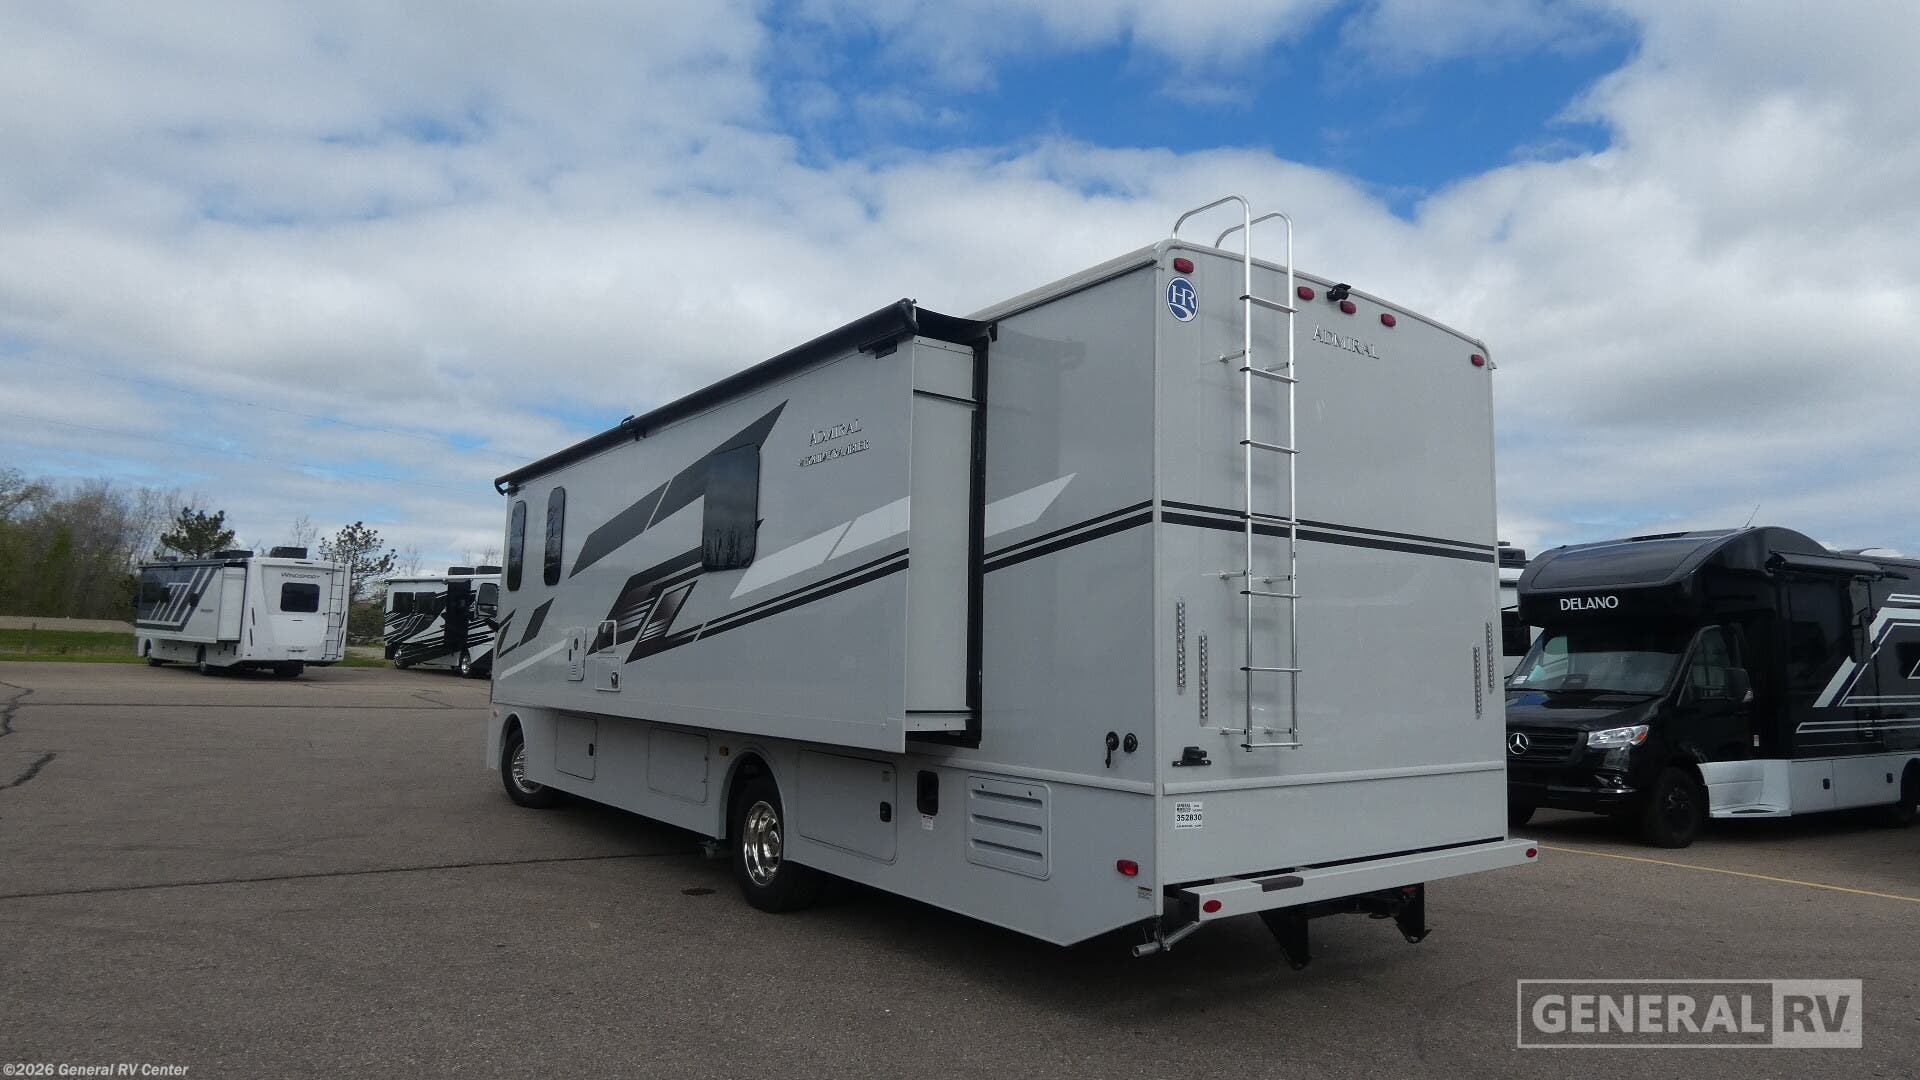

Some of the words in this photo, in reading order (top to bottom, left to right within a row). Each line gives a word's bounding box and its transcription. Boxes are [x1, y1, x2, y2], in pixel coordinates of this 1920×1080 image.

[1172, 285, 1196, 309] HR
[1313, 325, 1380, 359] ADMIRAL
[810, 419, 862, 446] ADMIRAL
[1560, 596, 1619, 611] DELANO
[1177, 814, 1203, 822] 352830
